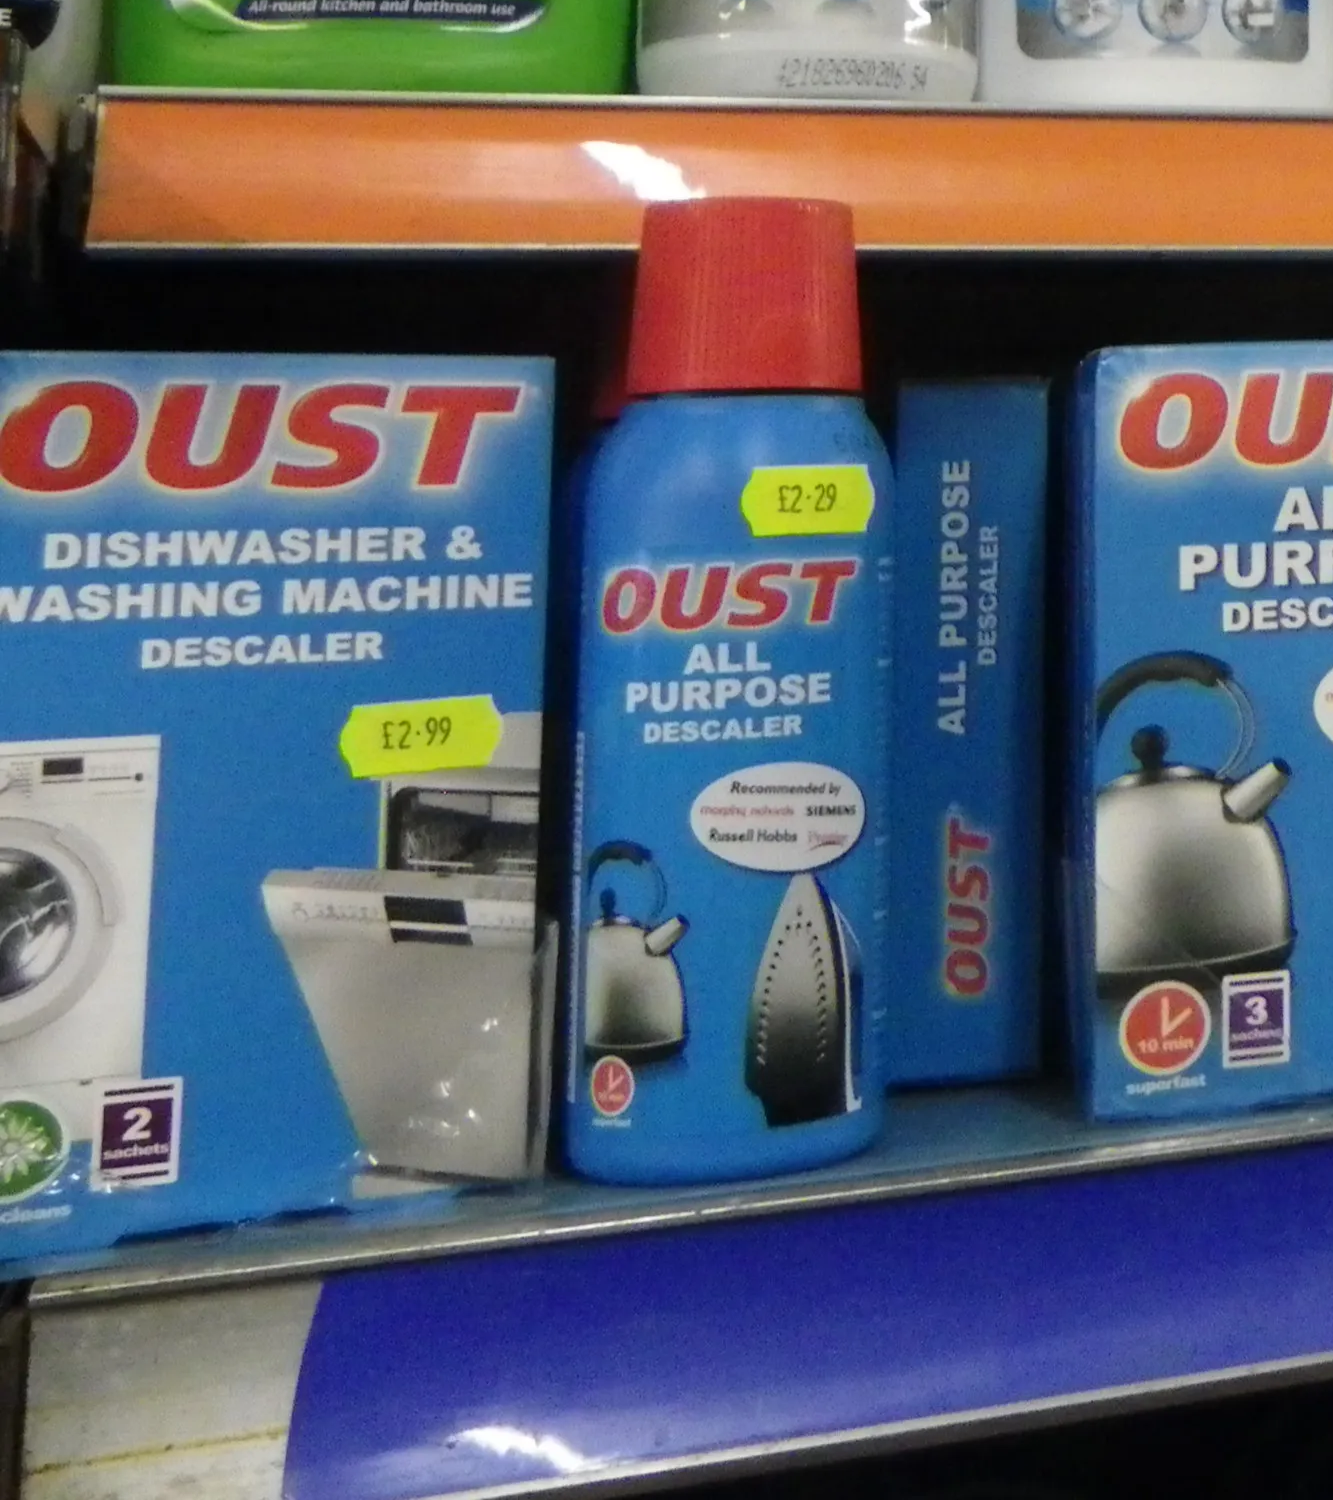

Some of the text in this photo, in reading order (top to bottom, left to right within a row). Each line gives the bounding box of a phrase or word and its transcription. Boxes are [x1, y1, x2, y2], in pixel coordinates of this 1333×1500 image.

[490, 2, 515, 16] use
[0, 379, 524, 493] OUST
[42, 524, 483, 571] DISHWASHER &
[0, 573, 534, 624] WASHING MACHINE
[602, 558, 857, 636] OUST
[937, 457, 972, 737] ALL PURPOSE
[976, 523, 999, 668] DESCALER
[141, 631, 384, 670] DESCALER
[684, 642, 771, 675] ALL
[625, 671, 832, 715] PURPOSE
[643, 714, 803, 744] DESCALER
[730, 780, 841, 797] Recommended by
[805, 805, 856, 817] SIEMENS
[709, 828, 798, 842] Russell Hobbs
[943, 816, 992, 996] OUST
[1244, 995, 1268, 1025] 3
[1138, 1036, 1194, 1053] 10 min
[1125, 1073, 1206, 1095] superfast
[121, 1108, 153, 1142] 2
[102, 1140, 170, 1162] sachets
